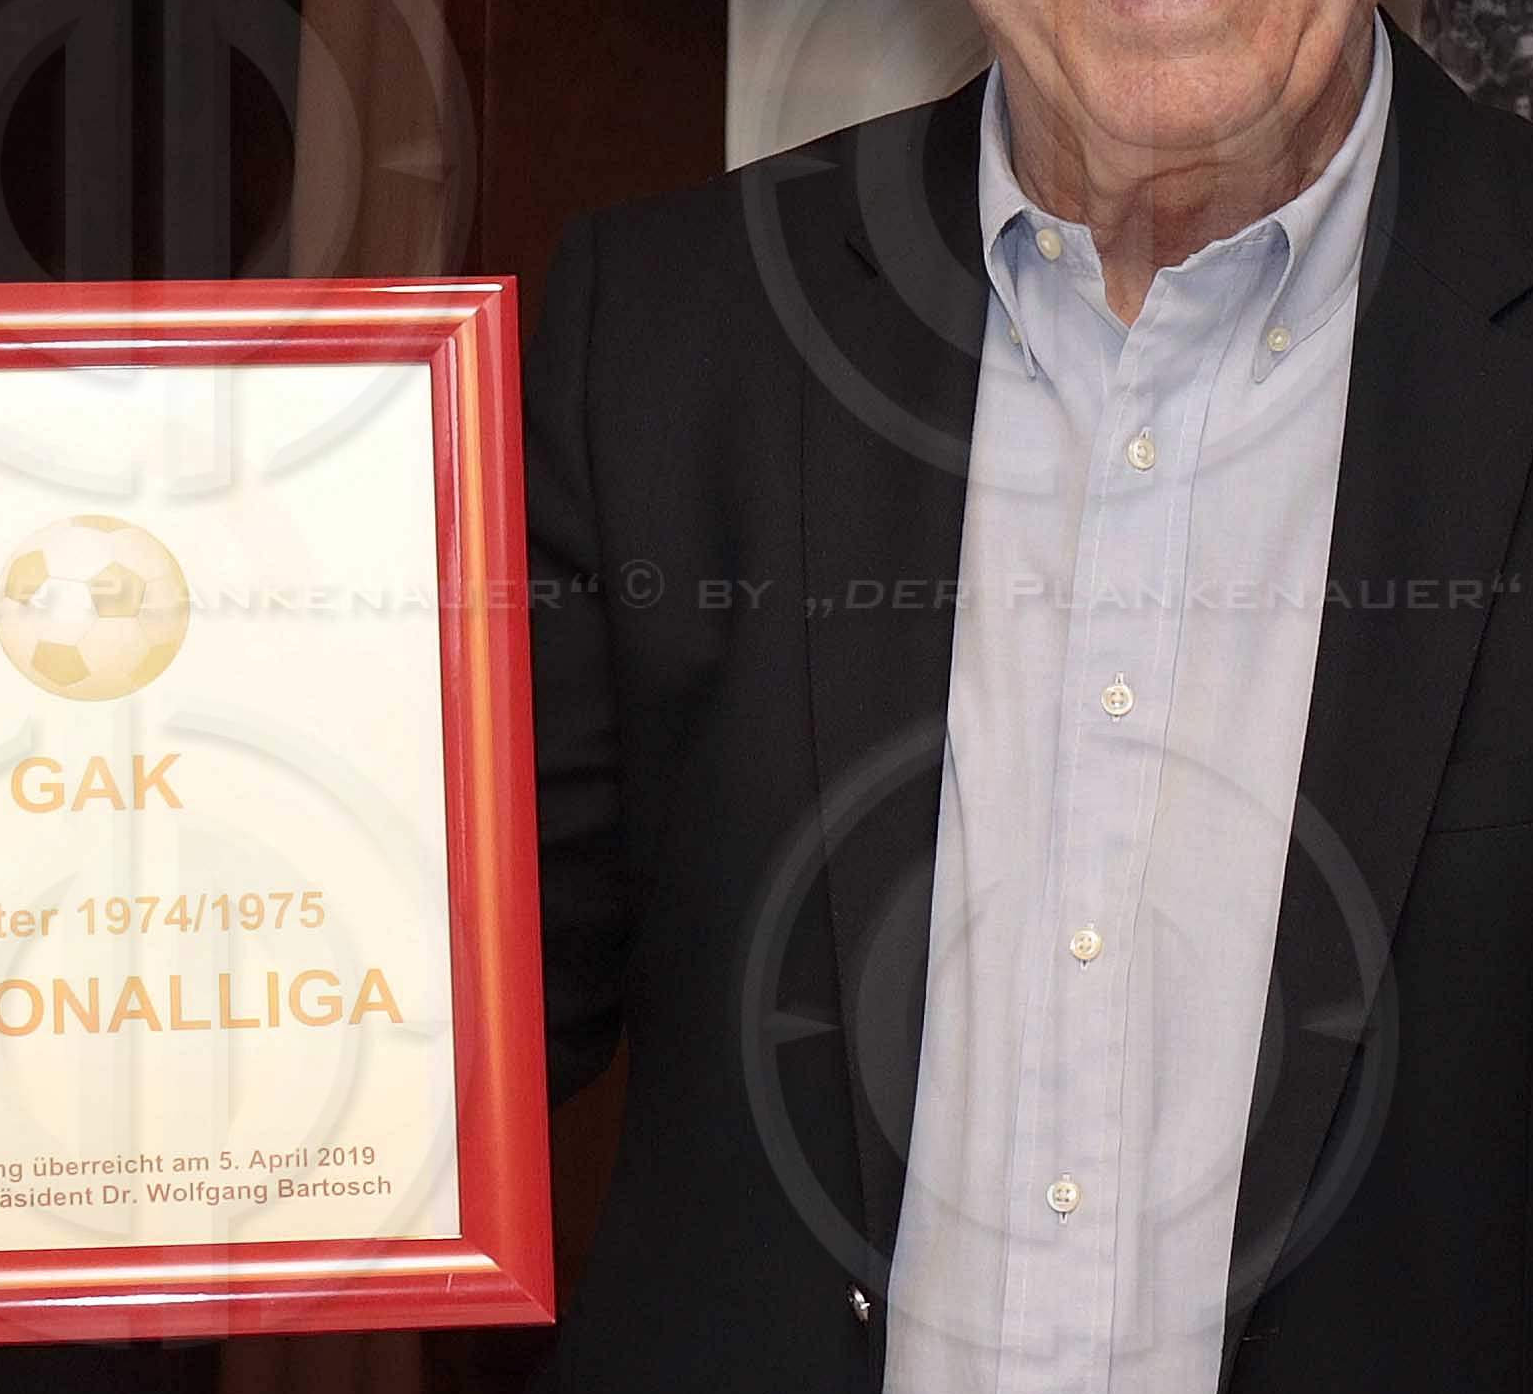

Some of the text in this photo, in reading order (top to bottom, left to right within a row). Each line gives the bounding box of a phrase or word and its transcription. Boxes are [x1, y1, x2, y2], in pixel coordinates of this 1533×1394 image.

[10, 753, 184, 814] GAK
[77, 891, 325, 935] 1974/1975
[33, 1154, 163, 1178] überreicht
[172, 1156, 209, 1173] am
[219, 1151, 239, 1170] 5.
[249, 1147, 308, 1174] April
[318, 1146, 375, 1167] 2019
[102, 1184, 138, 1205] Dr.
[147, 1181, 268, 1207] Wolfgang
[278, 1176, 392, 1200] Bartosch
